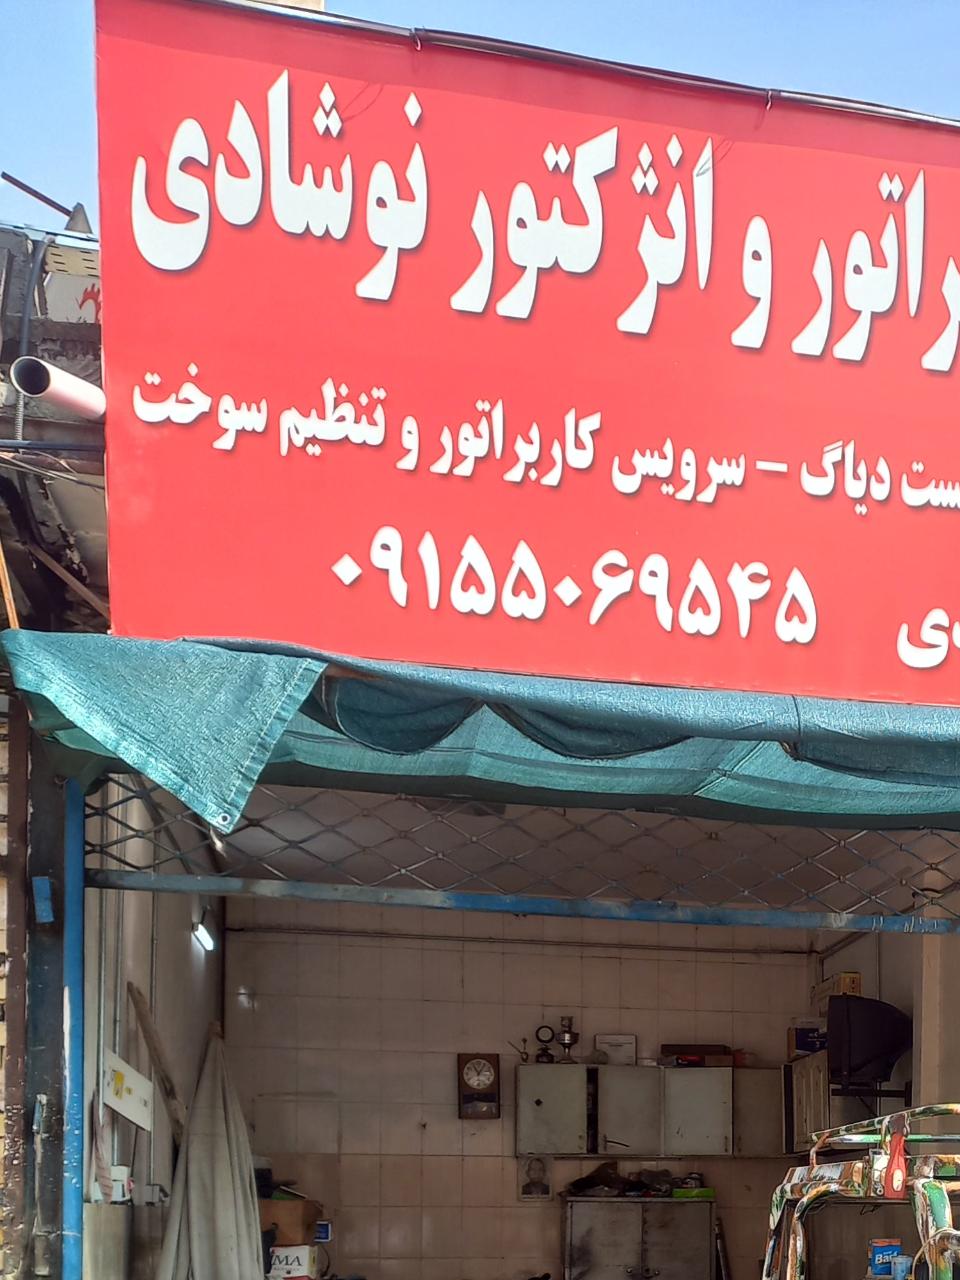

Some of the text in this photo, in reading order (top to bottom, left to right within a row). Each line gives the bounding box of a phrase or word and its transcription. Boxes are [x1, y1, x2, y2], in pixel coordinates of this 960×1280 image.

[131, 69, 429, 301] نوشادی
[450, 126, 715, 334] انژکتور
[730, 215, 772, 349] و
[132, 362, 268, 450] سوخت
[279, 377, 387, 457] تنظیم
[396, 415, 420, 471] و
[429, 399, 602, 486] کاربراتور
[612, 437, 747, 503] سرویس
[800, 440, 891, 516] دیاگ
[331, 526, 818, 646] ۰۹۱۵۵۰۶۹۵۴۵
